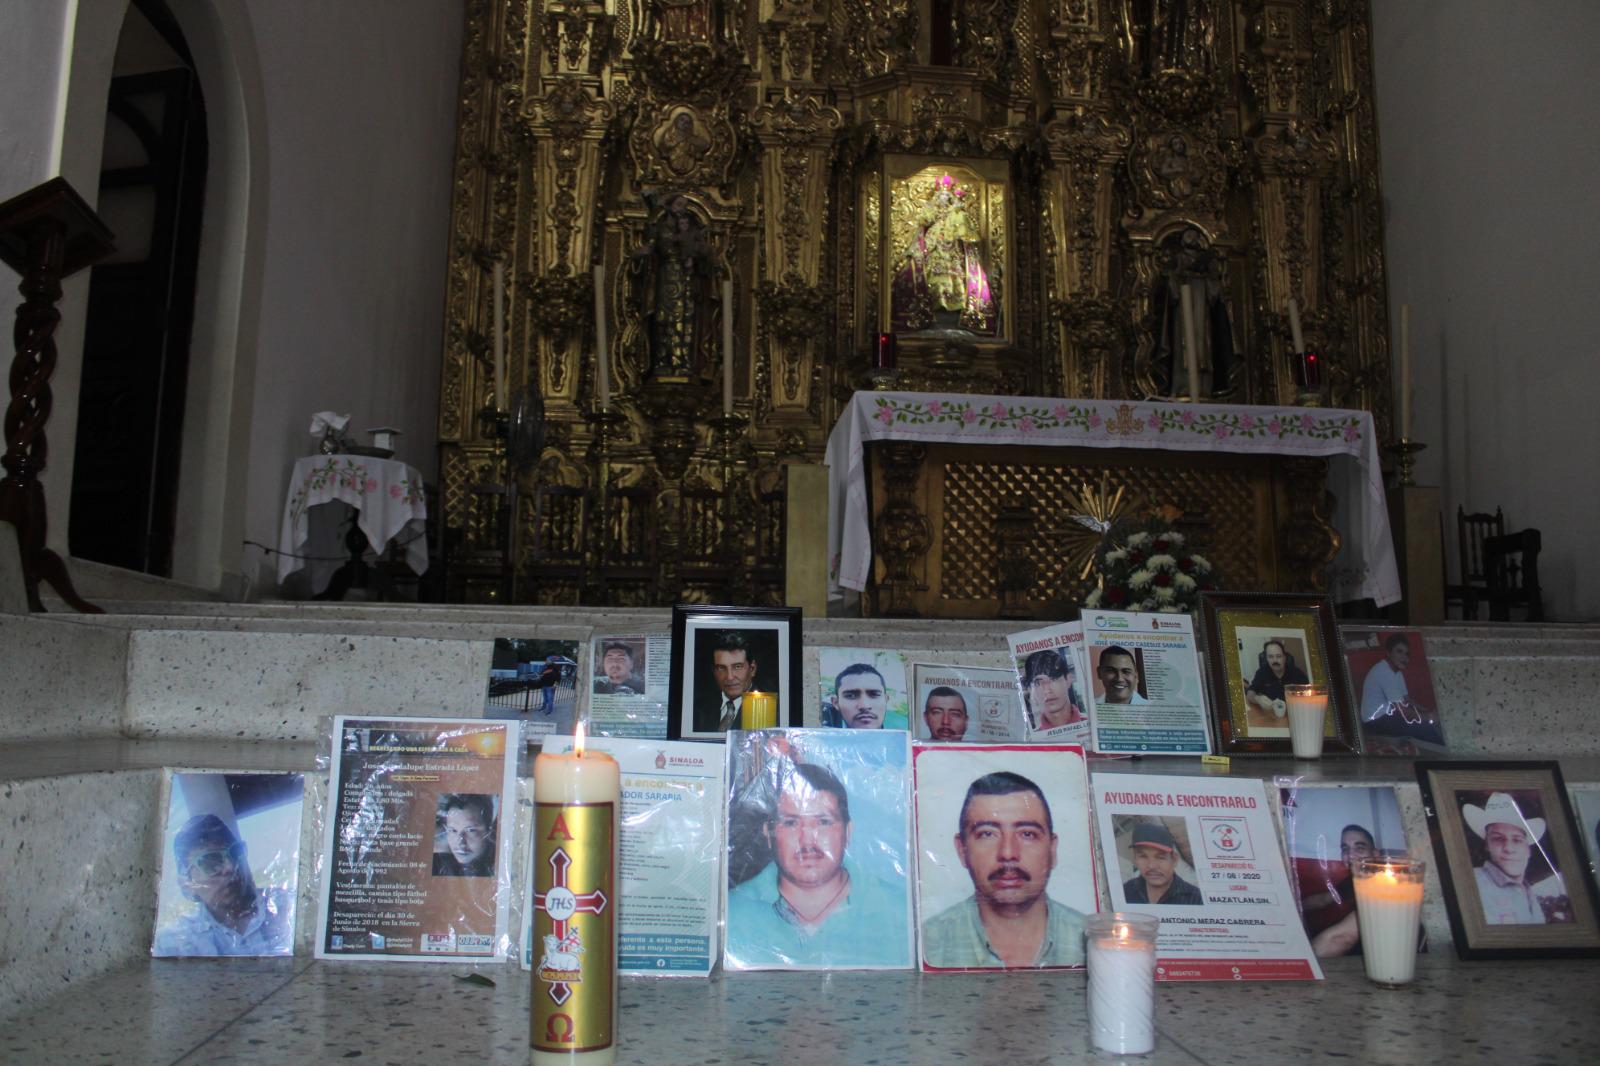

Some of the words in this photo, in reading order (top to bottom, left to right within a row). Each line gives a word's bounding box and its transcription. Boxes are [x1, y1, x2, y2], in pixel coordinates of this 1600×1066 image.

[1016, 637, 1054, 654] AYUDANOS
[1055, 636, 1061, 646] A
[925, 677, 960, 687] AYUDANOS
[669, 756, 704, 765] SINALOA
[456, 763, 479, 773] López
[1104, 791, 1164, 805] AYUDANOS
[1167, 793, 1175, 806] A
[1176, 793, 1257, 809] ENCONTRARLO
[547, 812, 575, 841] A
[1160, 917, 1196, 925] ANTONIO
[1197, 918, 1226, 926] MERAZ
[1226, 918, 1266, 926] CABRERA
